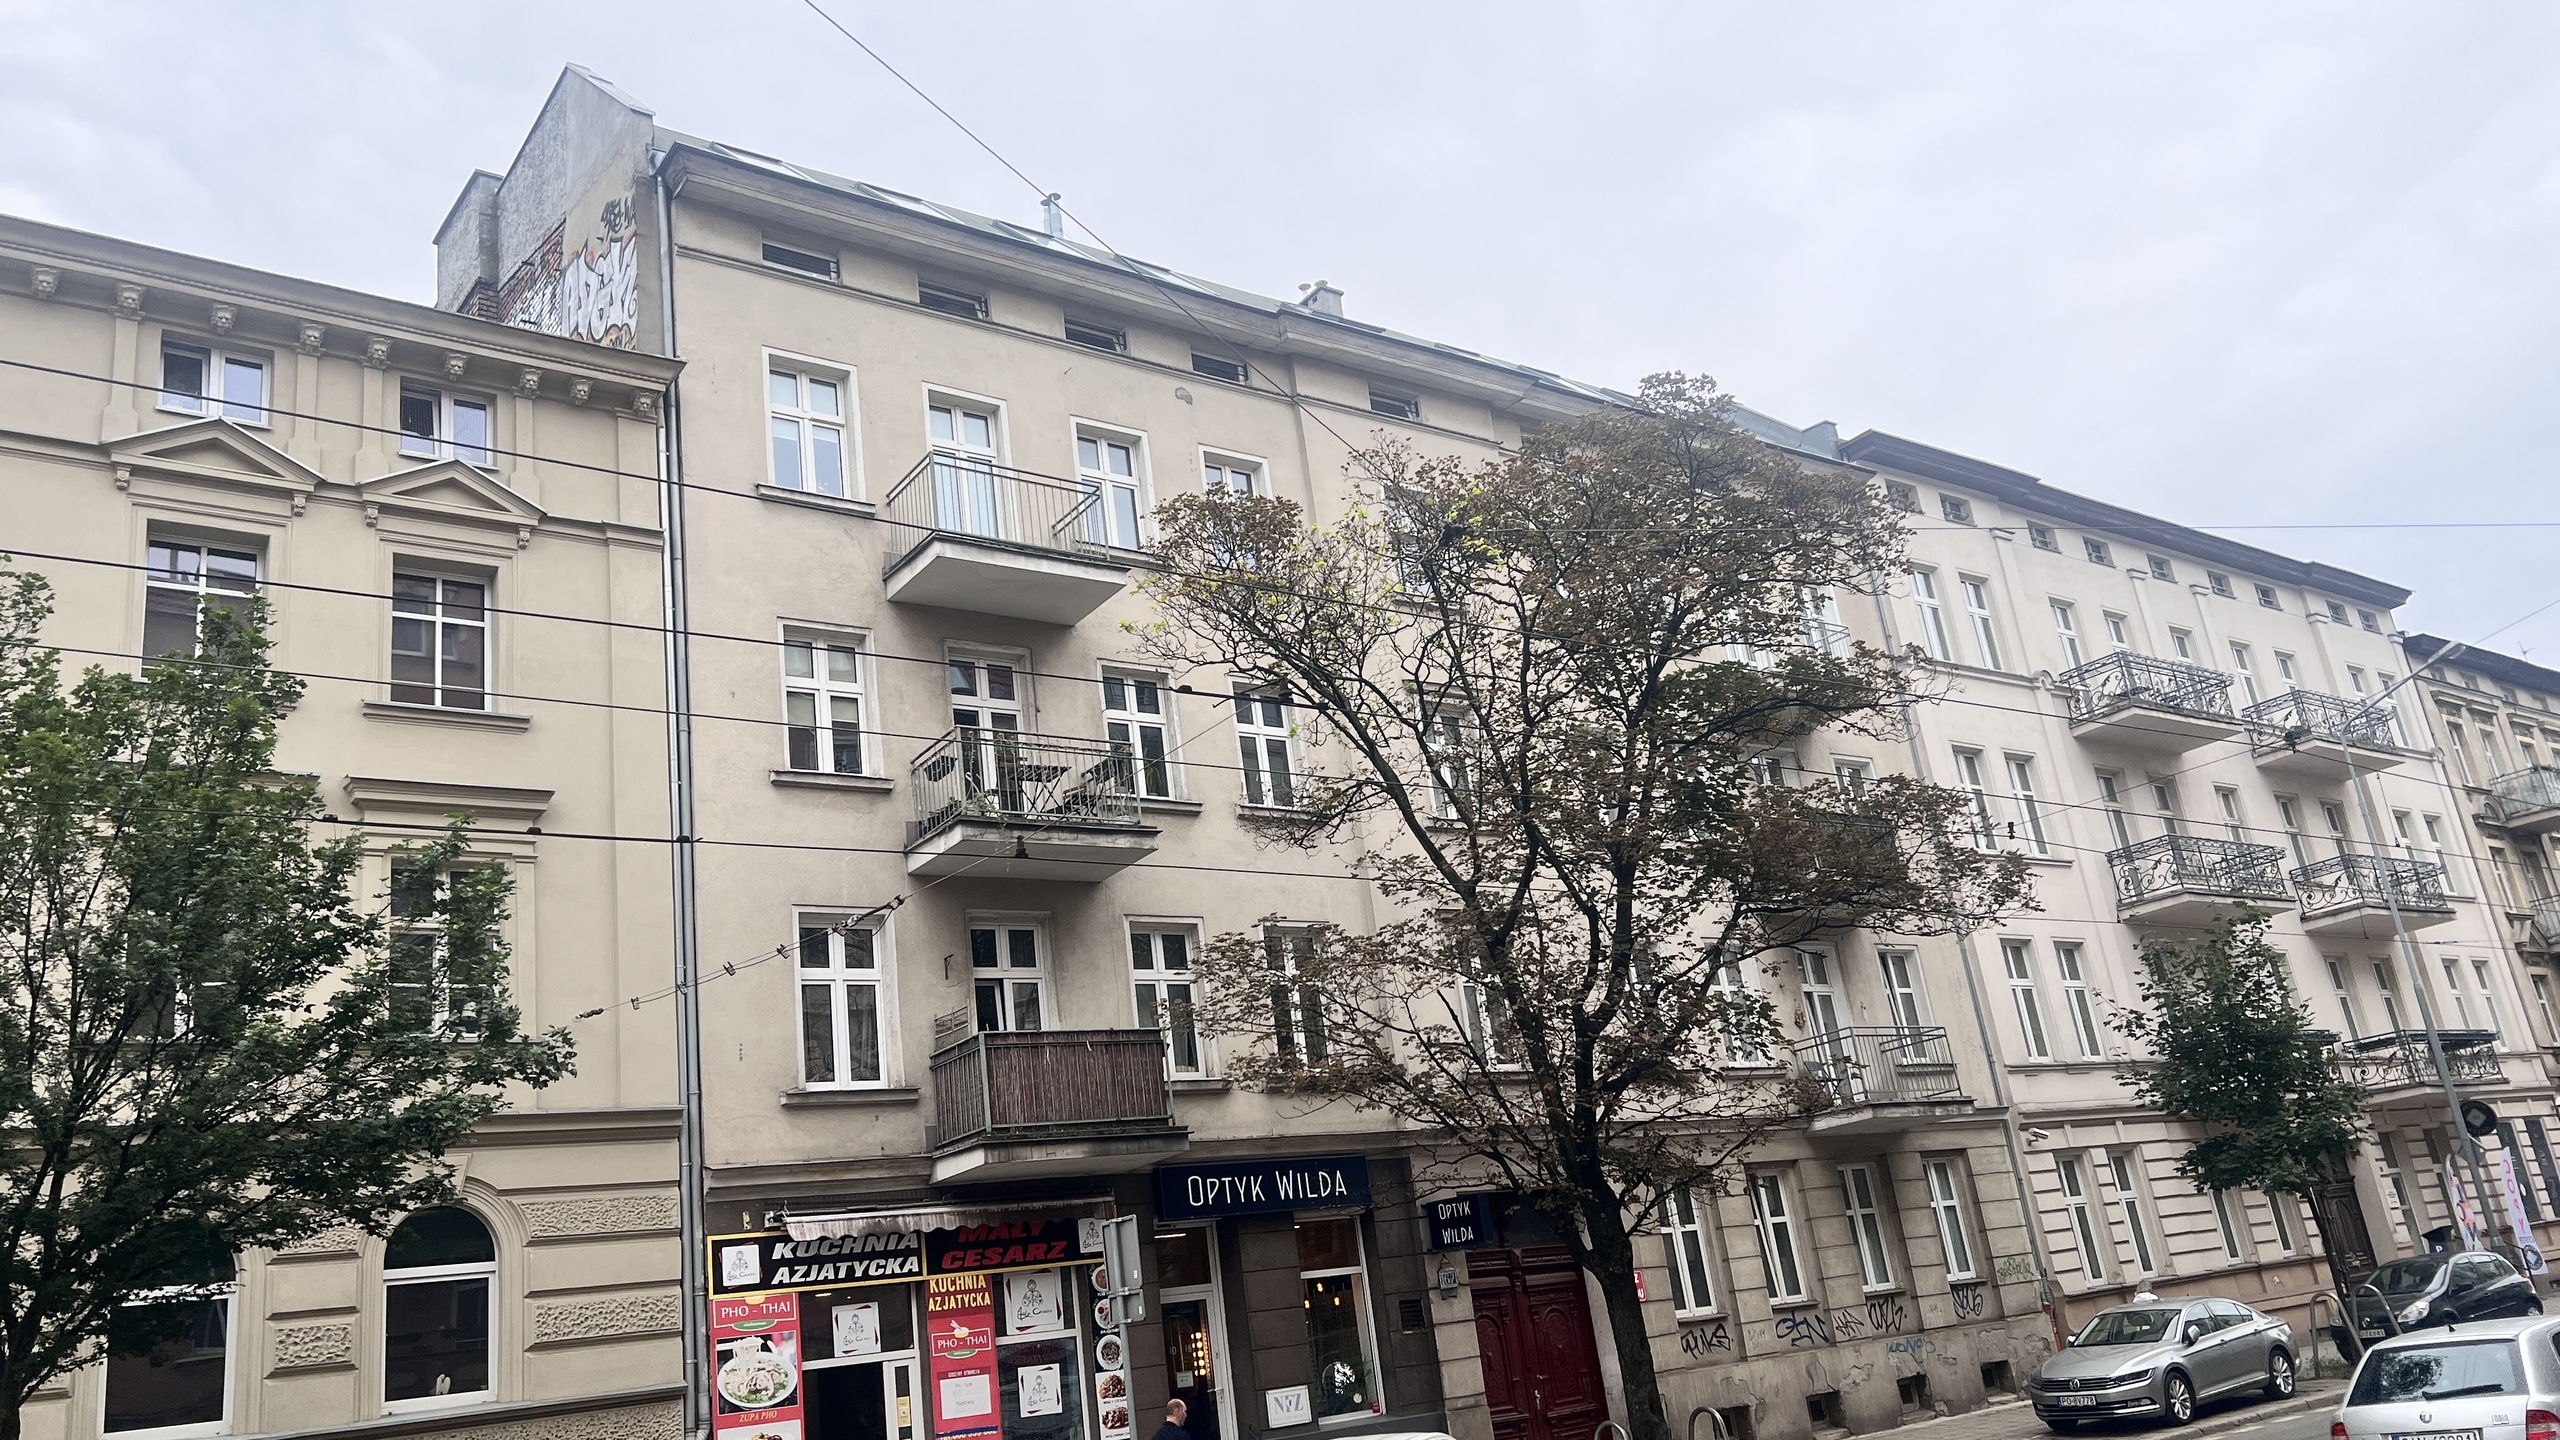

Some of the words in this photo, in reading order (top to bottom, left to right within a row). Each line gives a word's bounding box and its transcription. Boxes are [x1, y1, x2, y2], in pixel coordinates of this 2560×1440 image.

[1187, 1175, 1265, 1206] OPTYK
[1275, 1170, 1347, 1200] WILDA
[1438, 1201, 1471, 1220] OPTYK
[1442, 1226, 1474, 1244] WILDA
[771, 1232, 919, 1260] KUCHNIA
[941, 1241, 1068, 1269] CESARZ
[771, 1256, 920, 1285] AZJATYCKA
[929, 1274, 987, 1293] KUCHNIA
[721, 1306, 749, 1318] PHO
[760, 1302, 791, 1314] THAI
[928, 1292, 991, 1312] AZJATYCKA
[937, 1339, 958, 1349] PHO
[965, 1335, 987, 1346] THAI
[1273, 1393, 1303, 1414] NFZ
[739, 1413, 759, 1423] ZUPA
[760, 1411, 778, 1421] PHO
